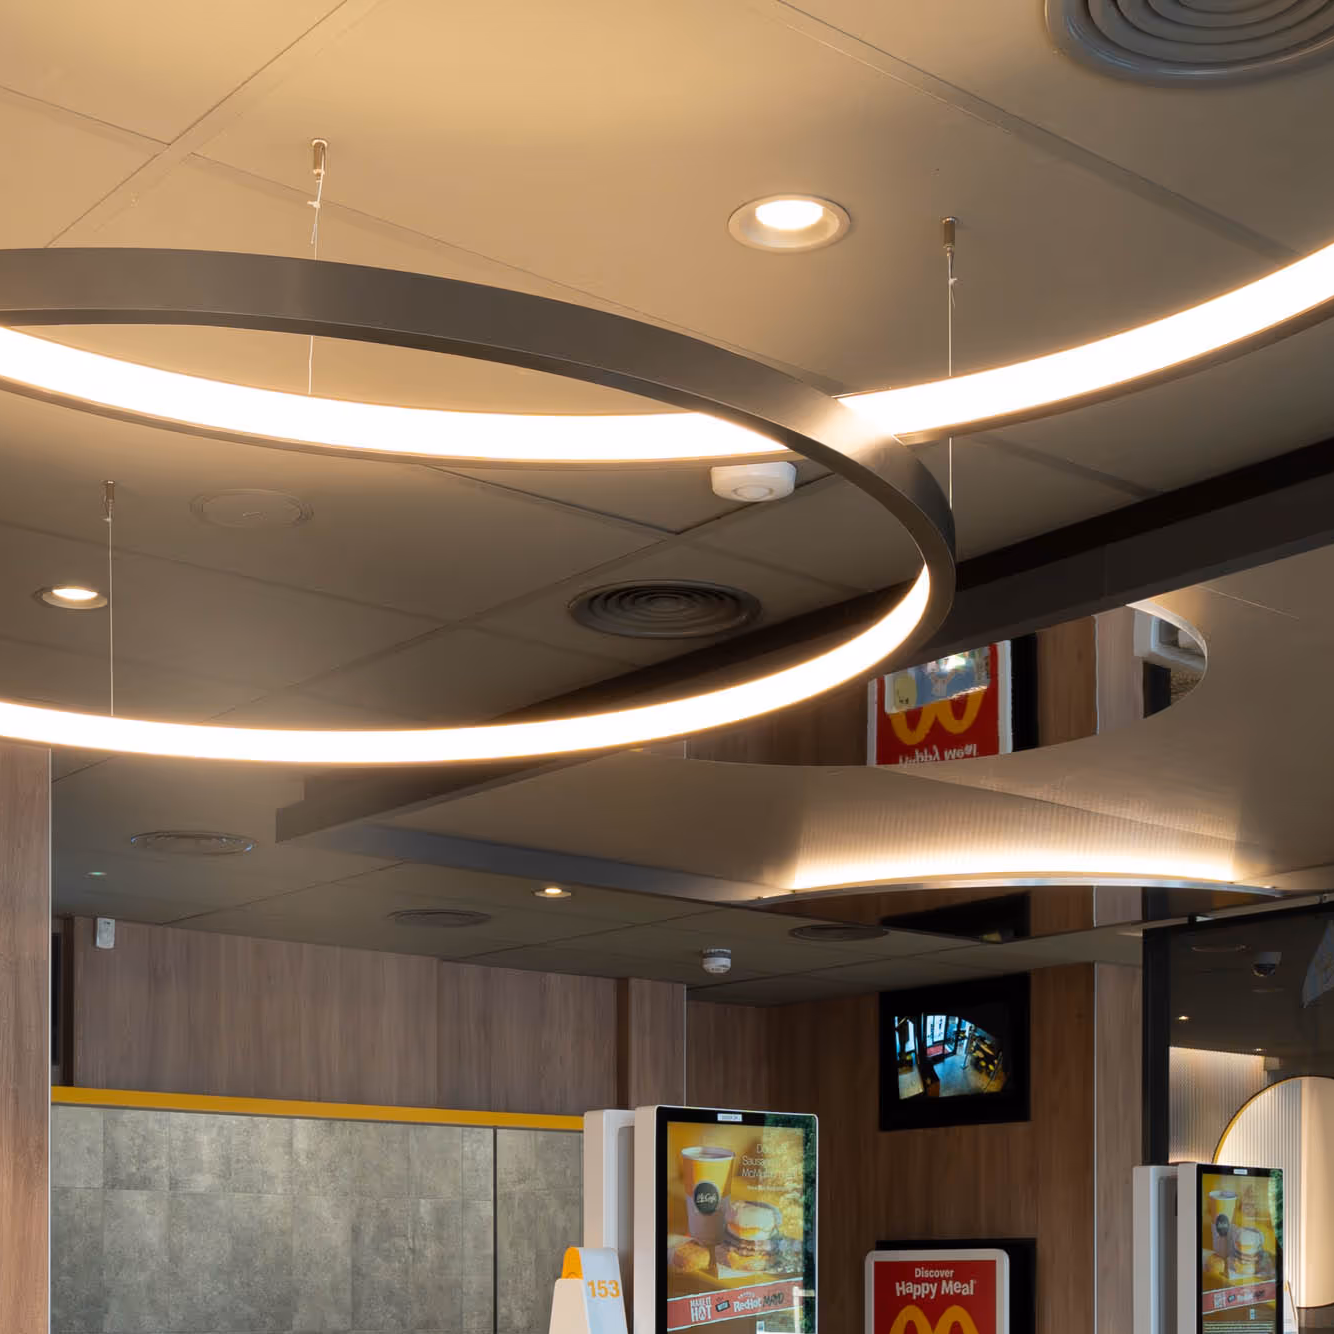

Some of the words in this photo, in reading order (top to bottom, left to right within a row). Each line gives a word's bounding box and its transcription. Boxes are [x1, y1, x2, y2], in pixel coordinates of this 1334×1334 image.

[914, 1267, 955, 1278] Discover
[587, 1279, 620, 1298] 153
[895, 1280, 938, 1300] Happy
[941, 1280, 974, 1296] Meal
